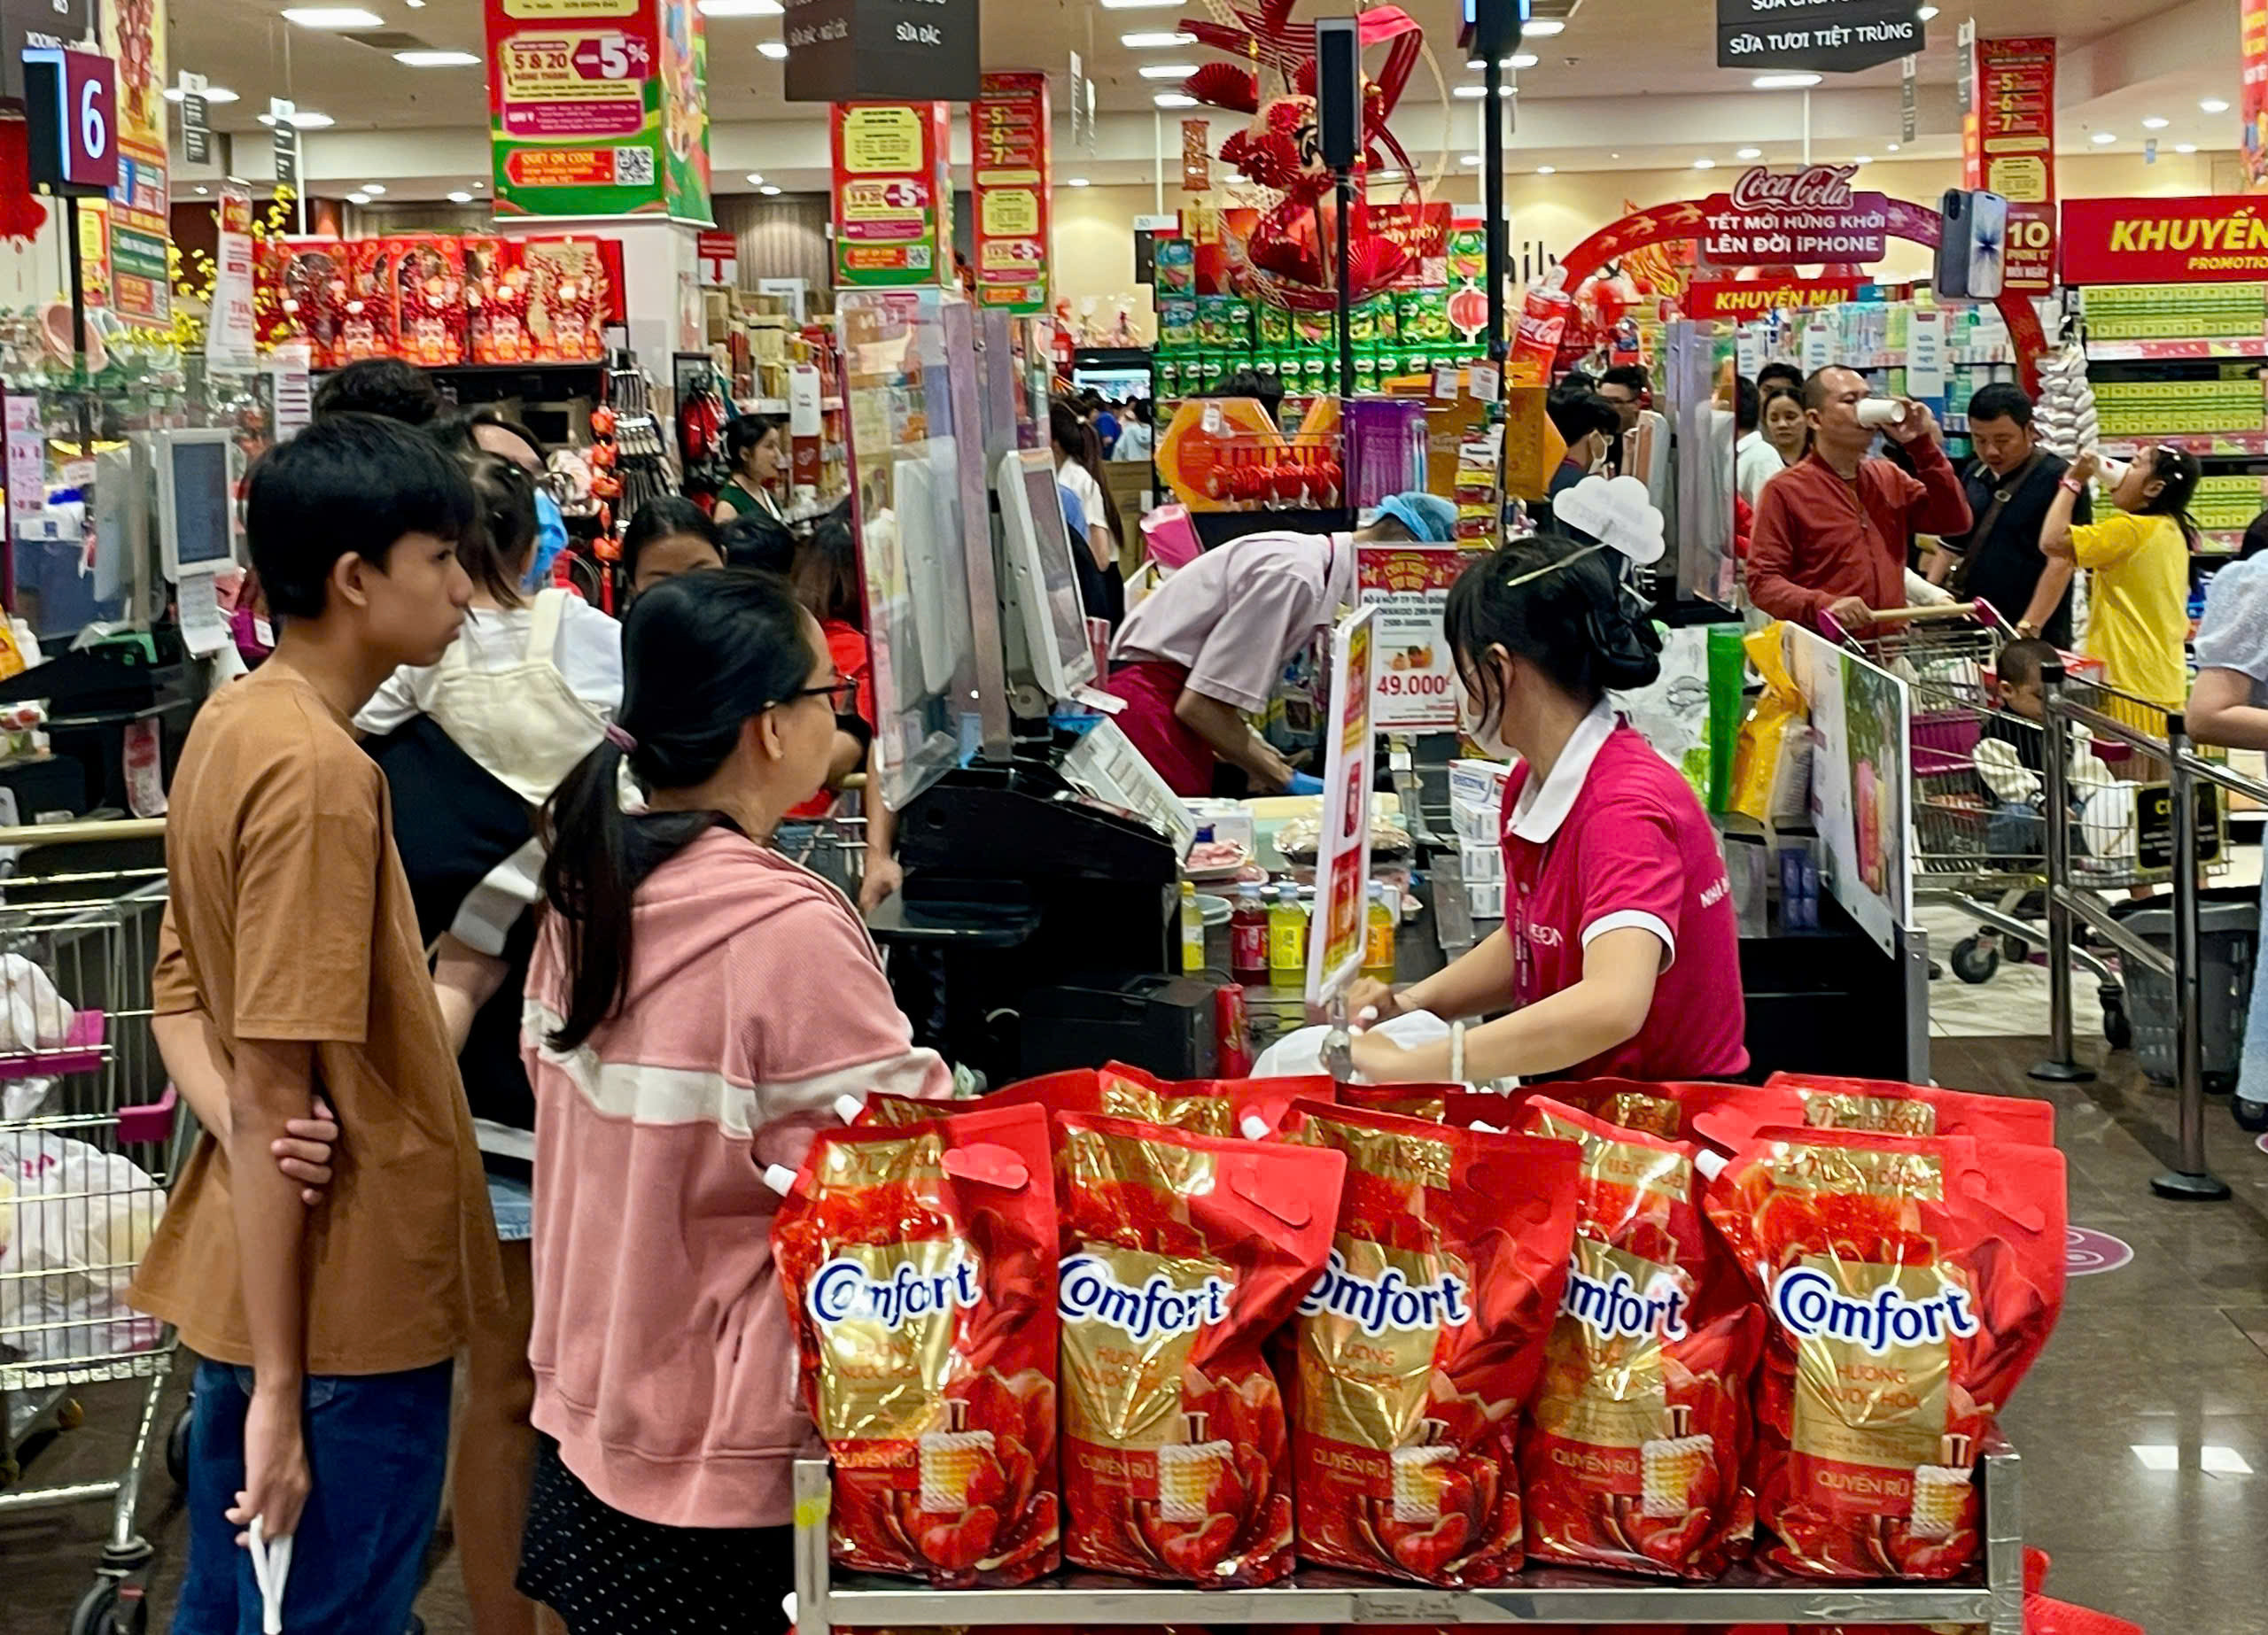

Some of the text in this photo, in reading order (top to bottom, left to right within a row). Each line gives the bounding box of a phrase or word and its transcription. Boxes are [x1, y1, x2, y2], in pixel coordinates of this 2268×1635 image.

[1729, 20, 1914, 54] SỮA TƯƠI TIỆT TRÙNG
[514, 54, 524, 69] 5
[547, 53, 568, 69] 20
[81, 79, 105, 159] 6
[1705, 212, 1740, 229] TẾT
[2008, 221, 2050, 248] 10
[2109, 205, 2268, 252] KHUYẾN
[1705, 232, 1879, 253] LÊN ĐỜI iPHONE
[1715, 284, 1804, 310] KHUYẾN
[1059, 1258, 1228, 1339] Comfort
[1299, 1252, 1467, 1331] omfort
[1566, 1258, 1684, 1335] mfort
[1778, 1272, 1975, 1351] Comfort
